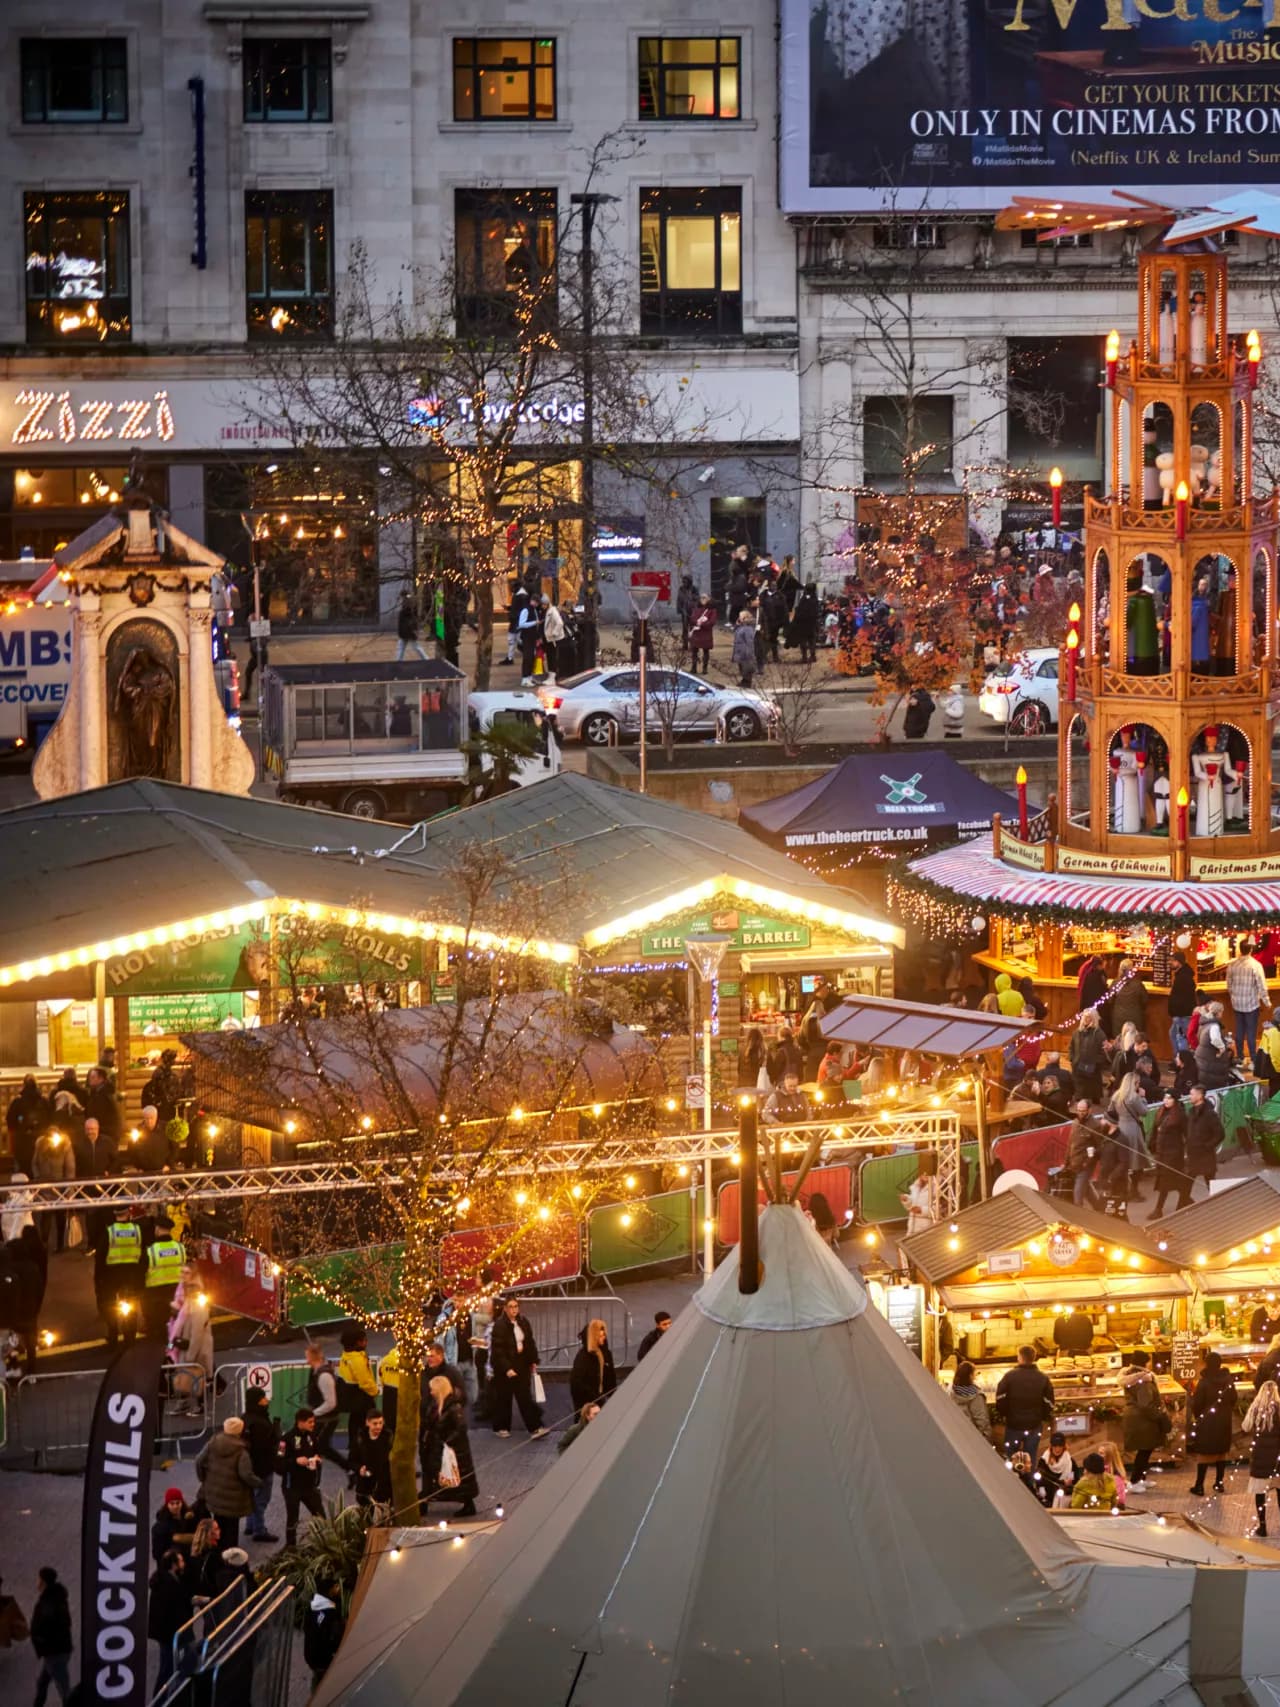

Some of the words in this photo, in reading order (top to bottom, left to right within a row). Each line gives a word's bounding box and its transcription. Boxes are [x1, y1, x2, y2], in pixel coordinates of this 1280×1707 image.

[1231, 27, 1258, 41] The
[1084, 84, 1127, 104] GET
[1131, 83, 1190, 103] YOUR
[910, 109, 1001, 137] ONLY
[1008, 109, 1044, 136] IN
[1051, 107, 1197, 136] CINEMAS
[1070, 149, 1129, 166] (Netflix
[1135, 150, 1160, 164] UK
[1166, 149, 1181, 164] &
[1187, 148, 1241, 165] Ireland
[0, 630, 71, 667] MB
[0, 682, 69, 704] COVE
[785, 827, 929, 848] www.thebeertruck.co.uk
[1063, 856, 1108, 868] German
[1110, 858, 1166, 873] Glühwein
[1199, 863, 1257, 875] Christmas
[651, 936, 682, 949] THE
[742, 931, 801, 945] BARREL
[108, 948, 155, 986] HOT
[96, 1392, 146, 1699] COCKTAILS
